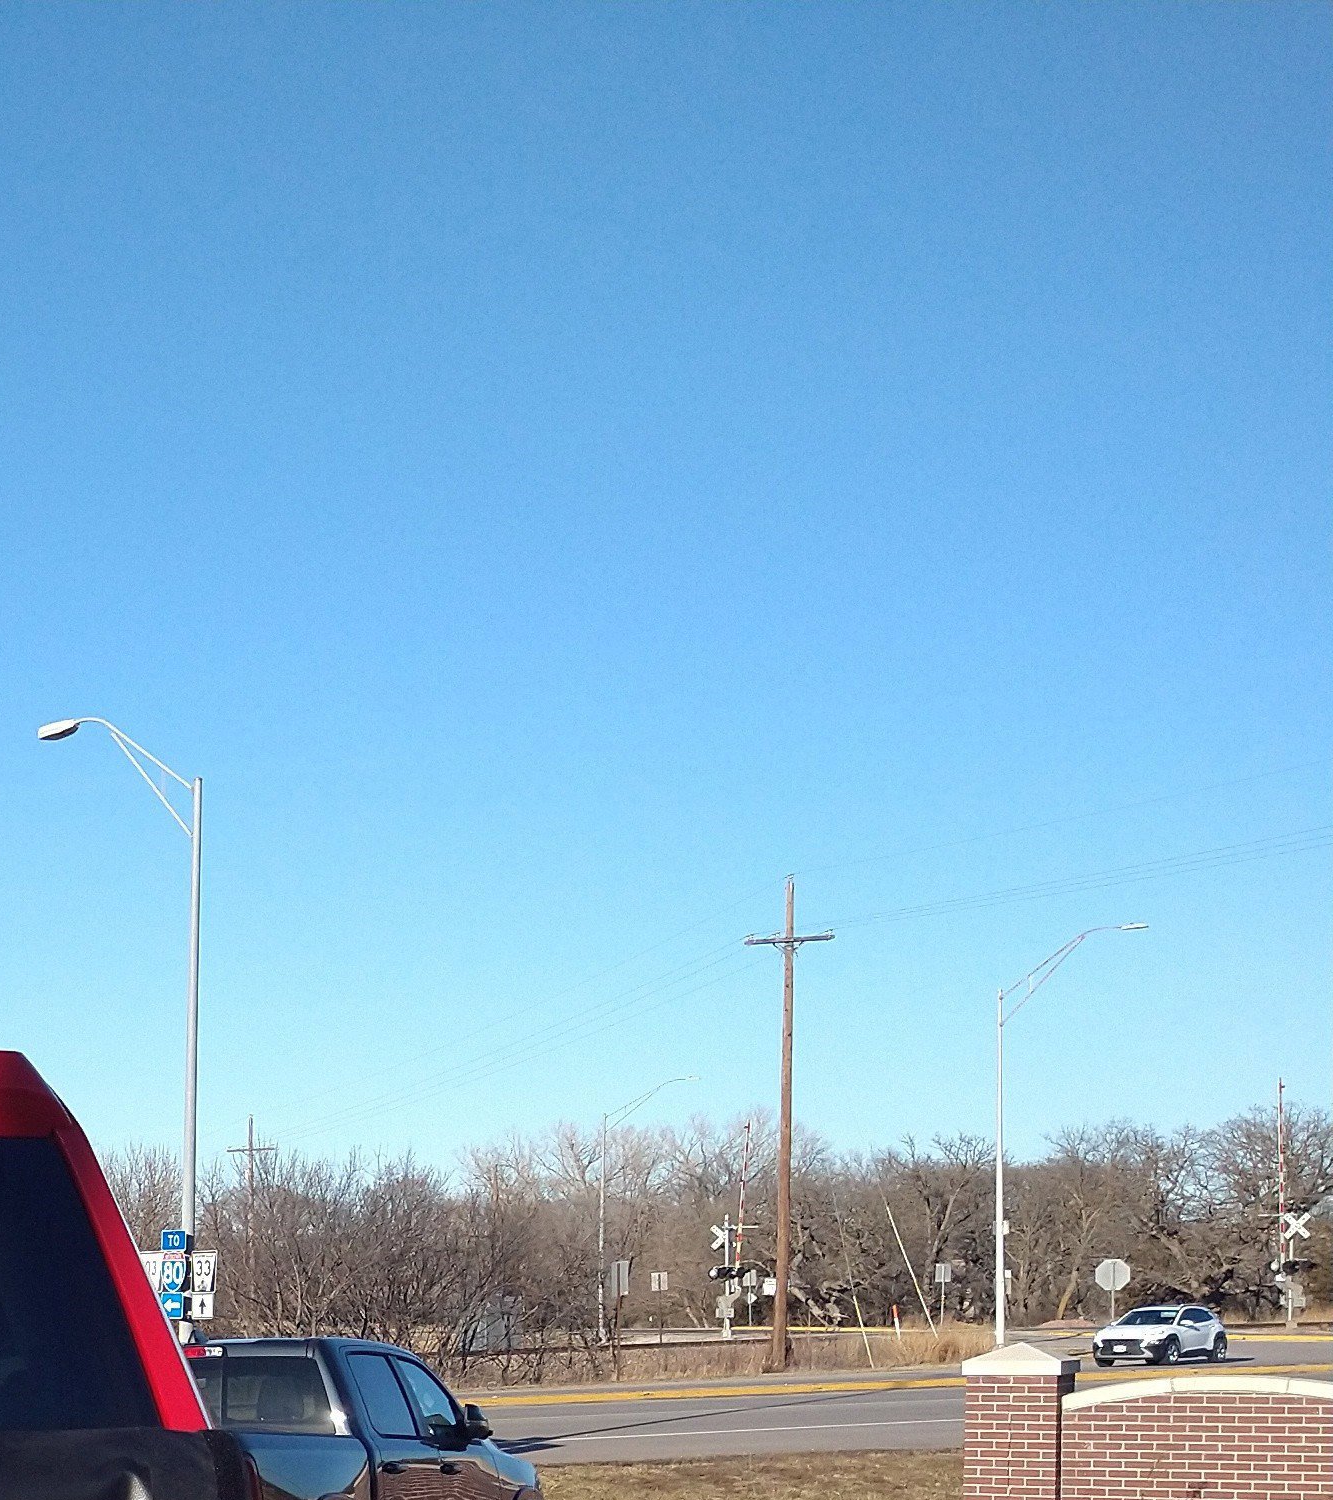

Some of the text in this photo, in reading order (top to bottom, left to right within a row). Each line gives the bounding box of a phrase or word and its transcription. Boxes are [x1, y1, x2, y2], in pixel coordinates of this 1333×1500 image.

[167, 1234, 180, 1247] TO
[163, 1261, 184, 1285] 80
[195, 1259, 211, 1277] 33
